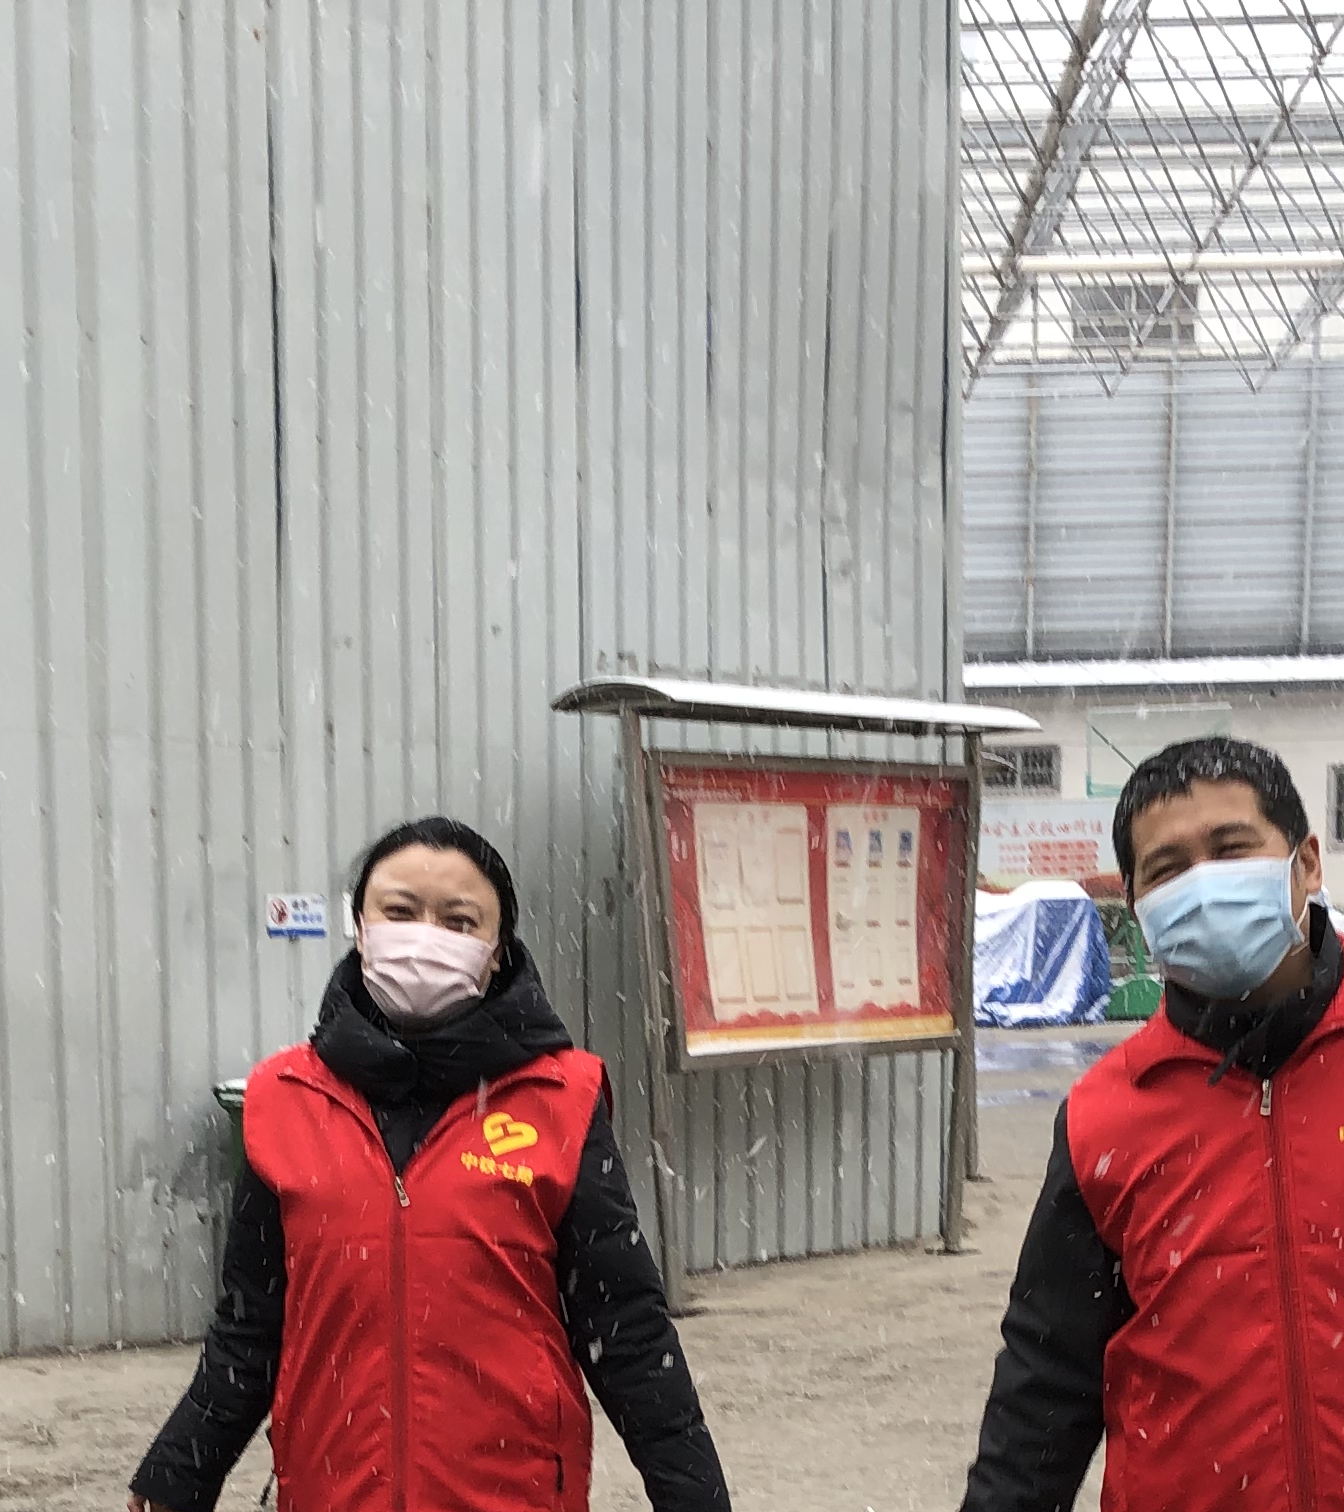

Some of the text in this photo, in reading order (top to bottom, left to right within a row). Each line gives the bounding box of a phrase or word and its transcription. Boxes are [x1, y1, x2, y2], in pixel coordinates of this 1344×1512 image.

[982, 819, 1116, 838] 社会主义核心价值
[460, 1150, 534, 1188] 中铁七局
